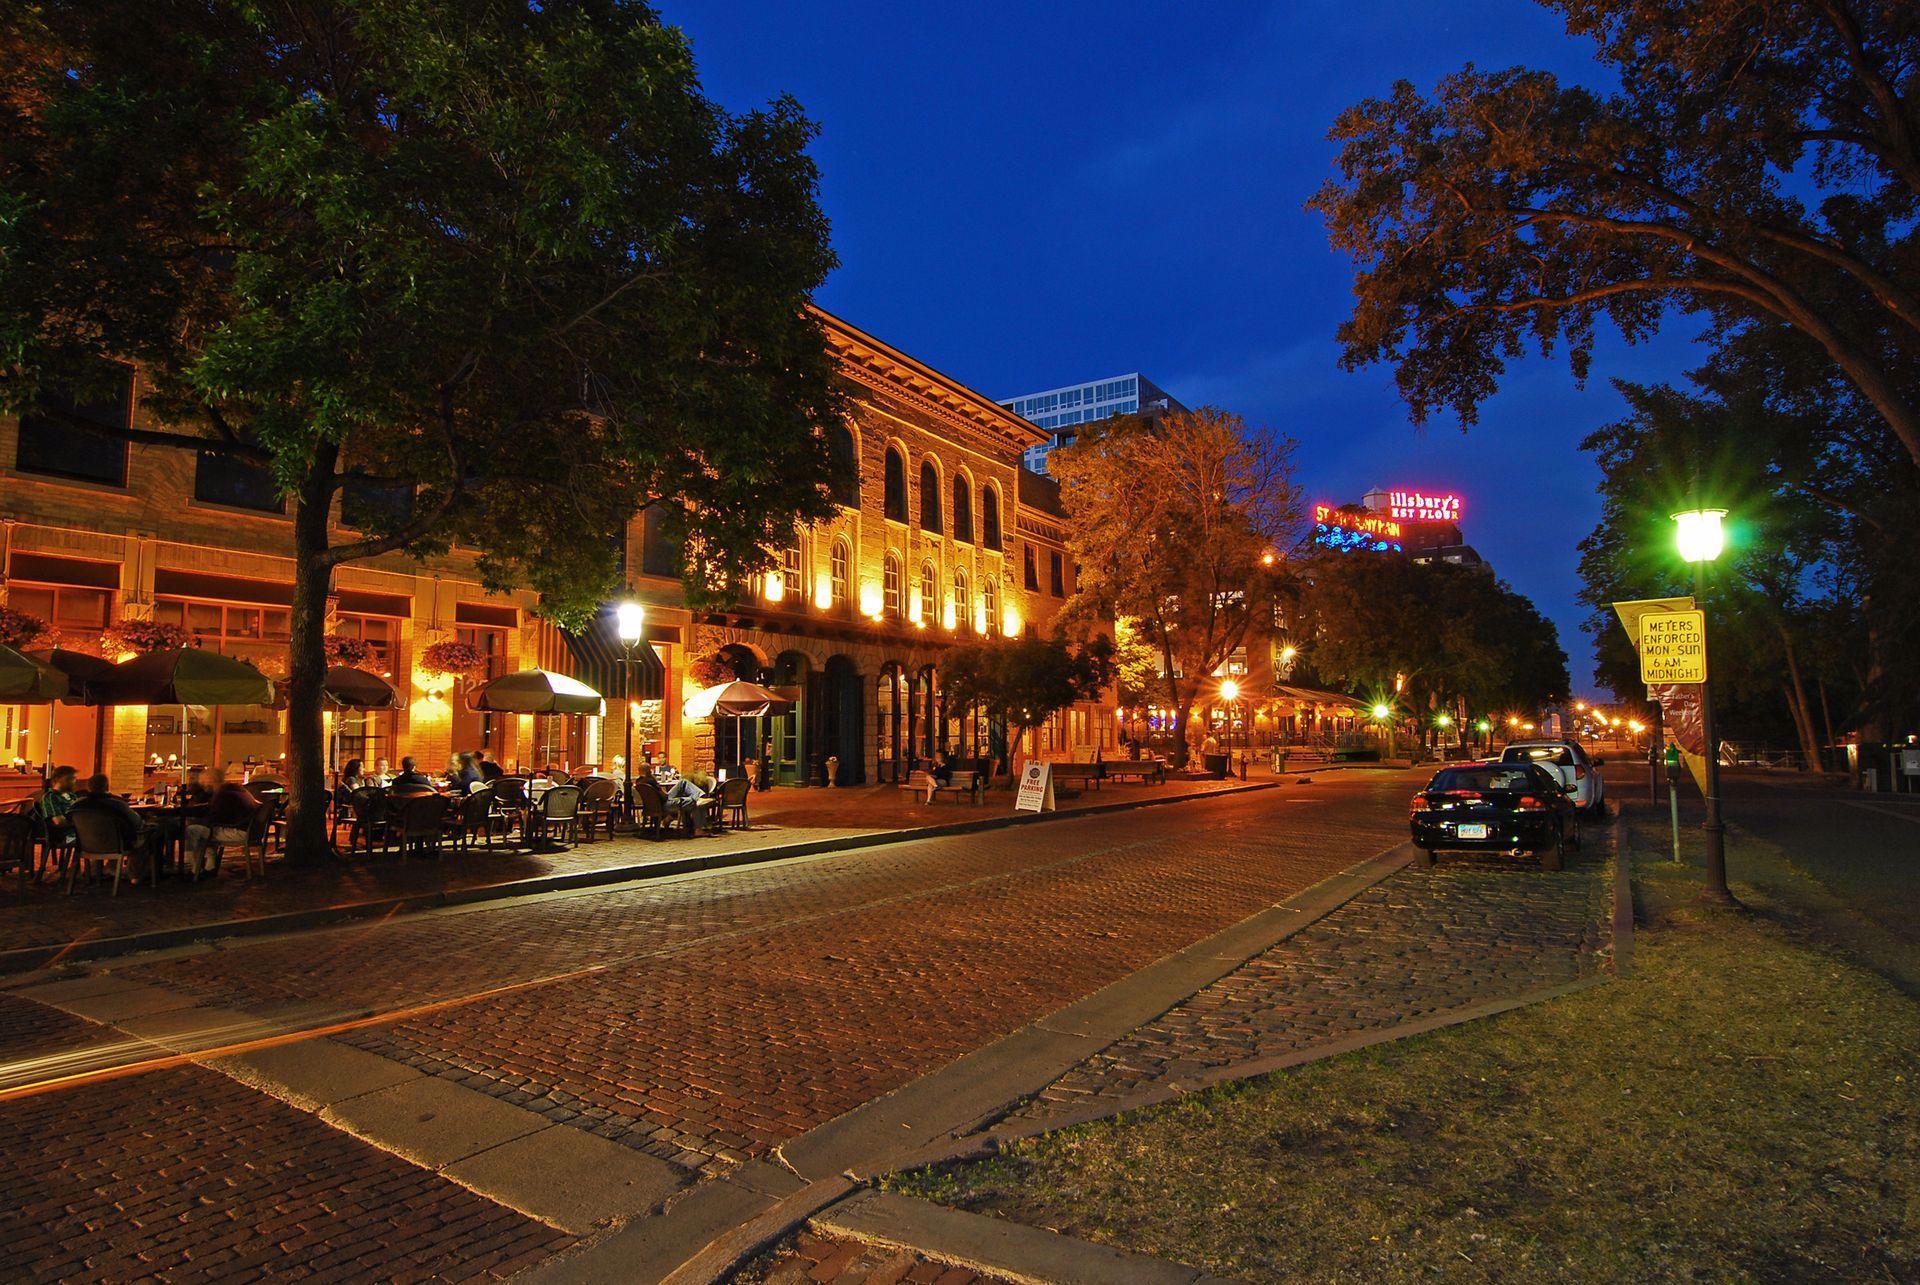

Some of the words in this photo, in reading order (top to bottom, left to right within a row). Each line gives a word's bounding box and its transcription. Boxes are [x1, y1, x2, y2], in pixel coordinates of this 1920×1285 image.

[1390, 492, 1459, 510] illsbury's
[1391, 507, 1415, 518] EST
[1419, 508, 1459, 520] FLOUR
[1650, 621, 1693, 632] METERS
[1643, 633, 1700, 644] ENFORCED
[1653, 658, 1660, 667] 6
[1647, 668, 1699, 679] MIDNIGHT
[1021, 784, 1043, 793] PARKING
